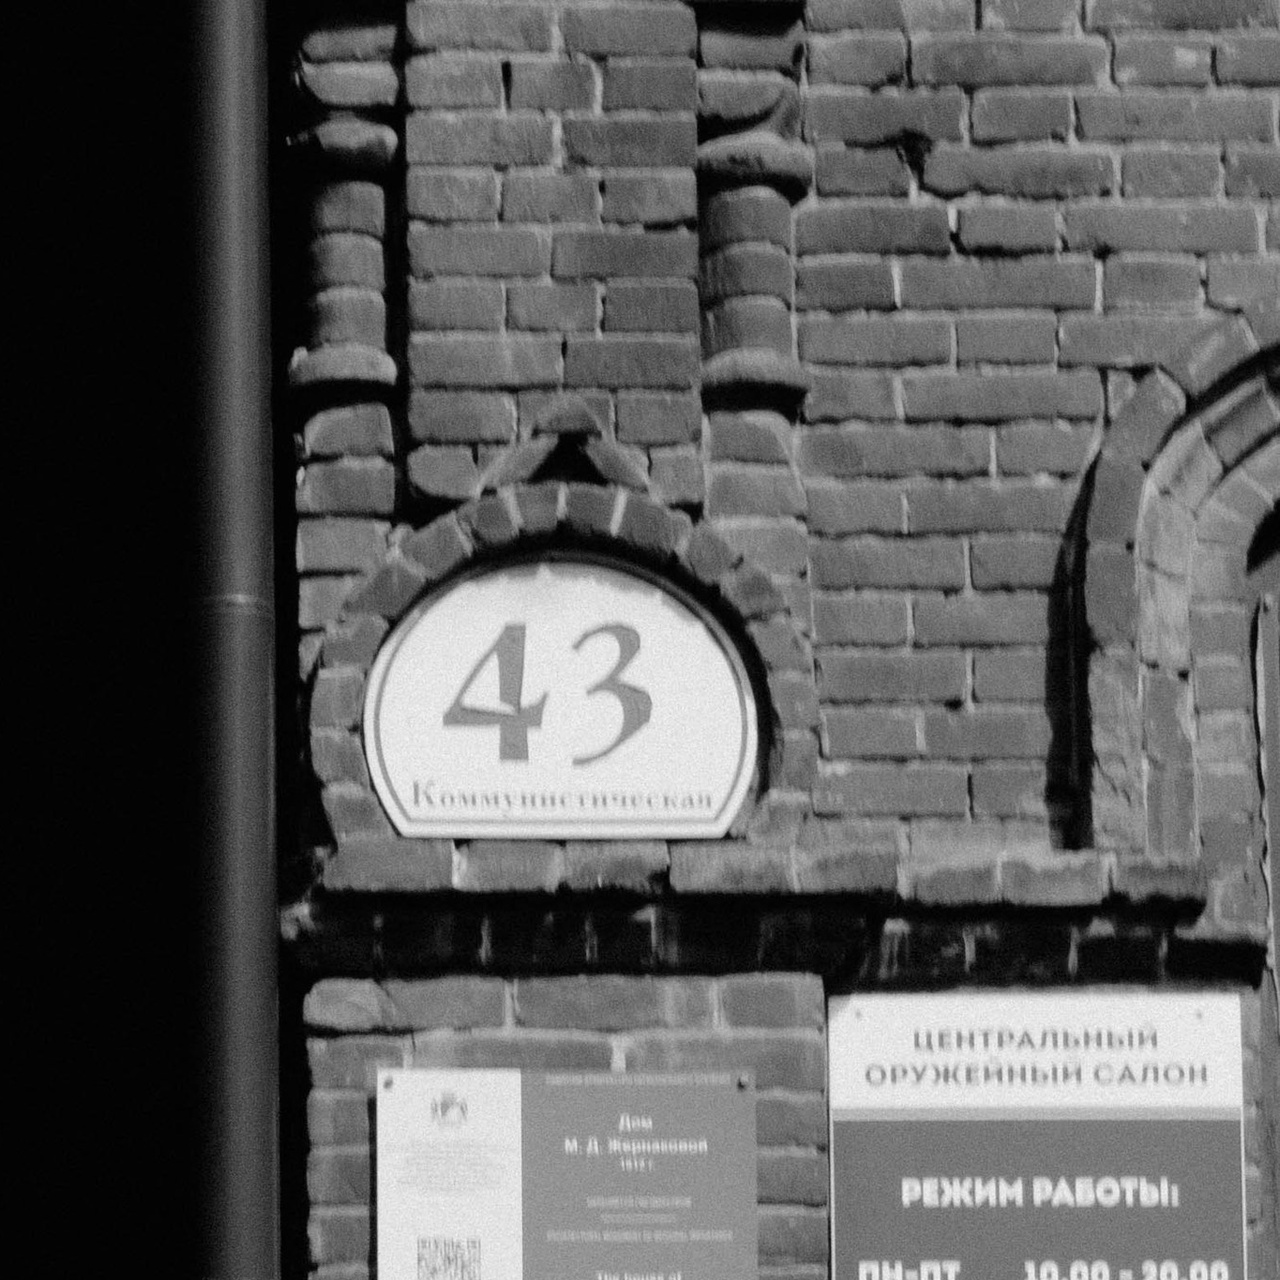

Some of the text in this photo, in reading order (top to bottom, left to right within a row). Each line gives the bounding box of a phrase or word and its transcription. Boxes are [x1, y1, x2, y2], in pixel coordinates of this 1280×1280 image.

[442, 622, 653, 768] 43
[412, 781, 713, 816] Коммунистическая
[913, 1026, 1158, 1053] ЦЕНТРАЛЬНЫЙ
[864, 1057, 1208, 1086] ОРУЖЕЙНЫЙ САЛОН
[901, 1178, 1024, 1208] РЕЖИМ
